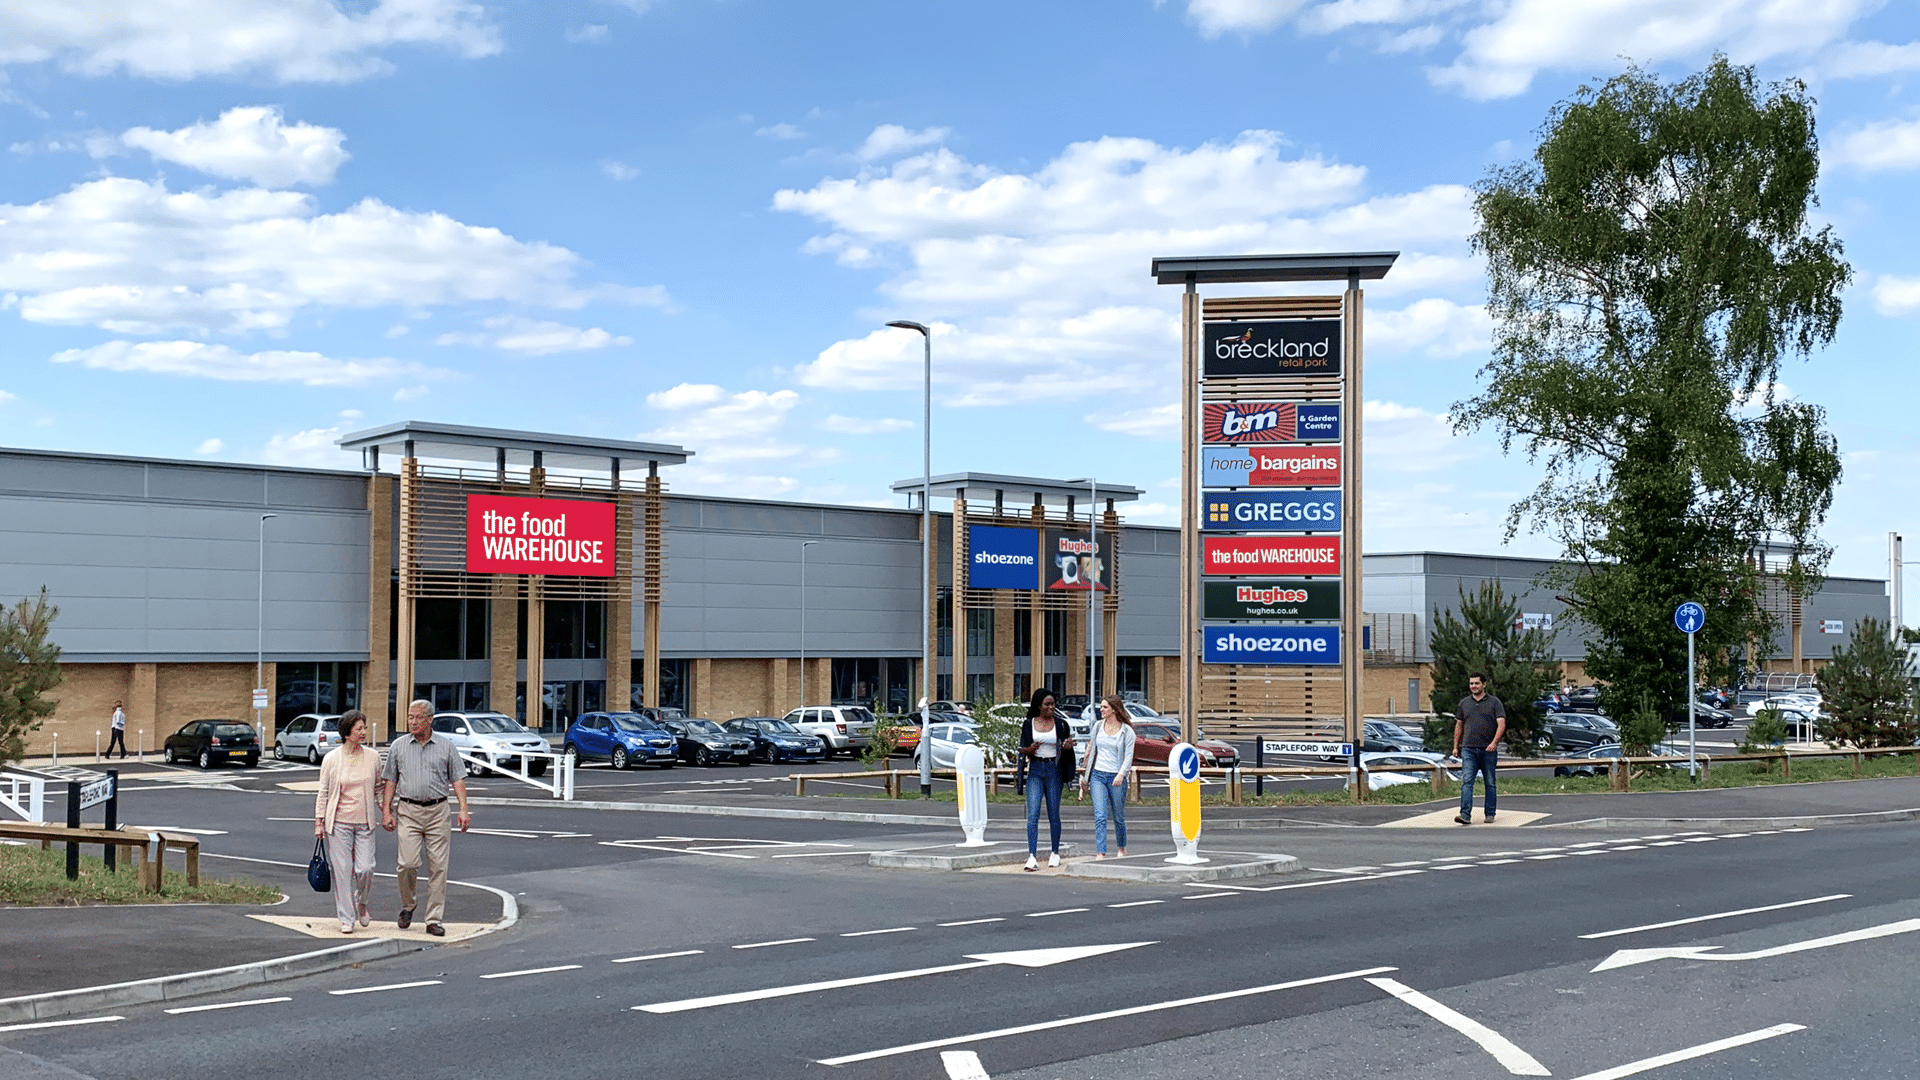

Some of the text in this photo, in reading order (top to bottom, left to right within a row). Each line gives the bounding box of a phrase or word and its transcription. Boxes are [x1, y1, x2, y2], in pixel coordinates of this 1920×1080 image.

[1216, 337, 1329, 360] breckland
[1279, 358, 1328, 369] retail park
[1223, 410, 1278, 436] b&m
[1304, 422, 1332, 430] Centre
[1308, 414, 1338, 422] Garden
[1210, 455, 1337, 473] home bargains
[1234, 502, 1336, 521] GREGGS
[483, 510, 566, 537] the food
[483, 536, 604, 564] WAREHOUSE
[975, 550, 1034, 565] shoezone
[1212, 548, 1335, 564] the food WAREHOUSE
[1236, 586, 1309, 605] Hughes
[1246, 606, 1299, 615] hughes.co.uk
[1216, 633, 1327, 652] shoezone
[1265, 743, 1340, 753] STAPLEFORD WAY
